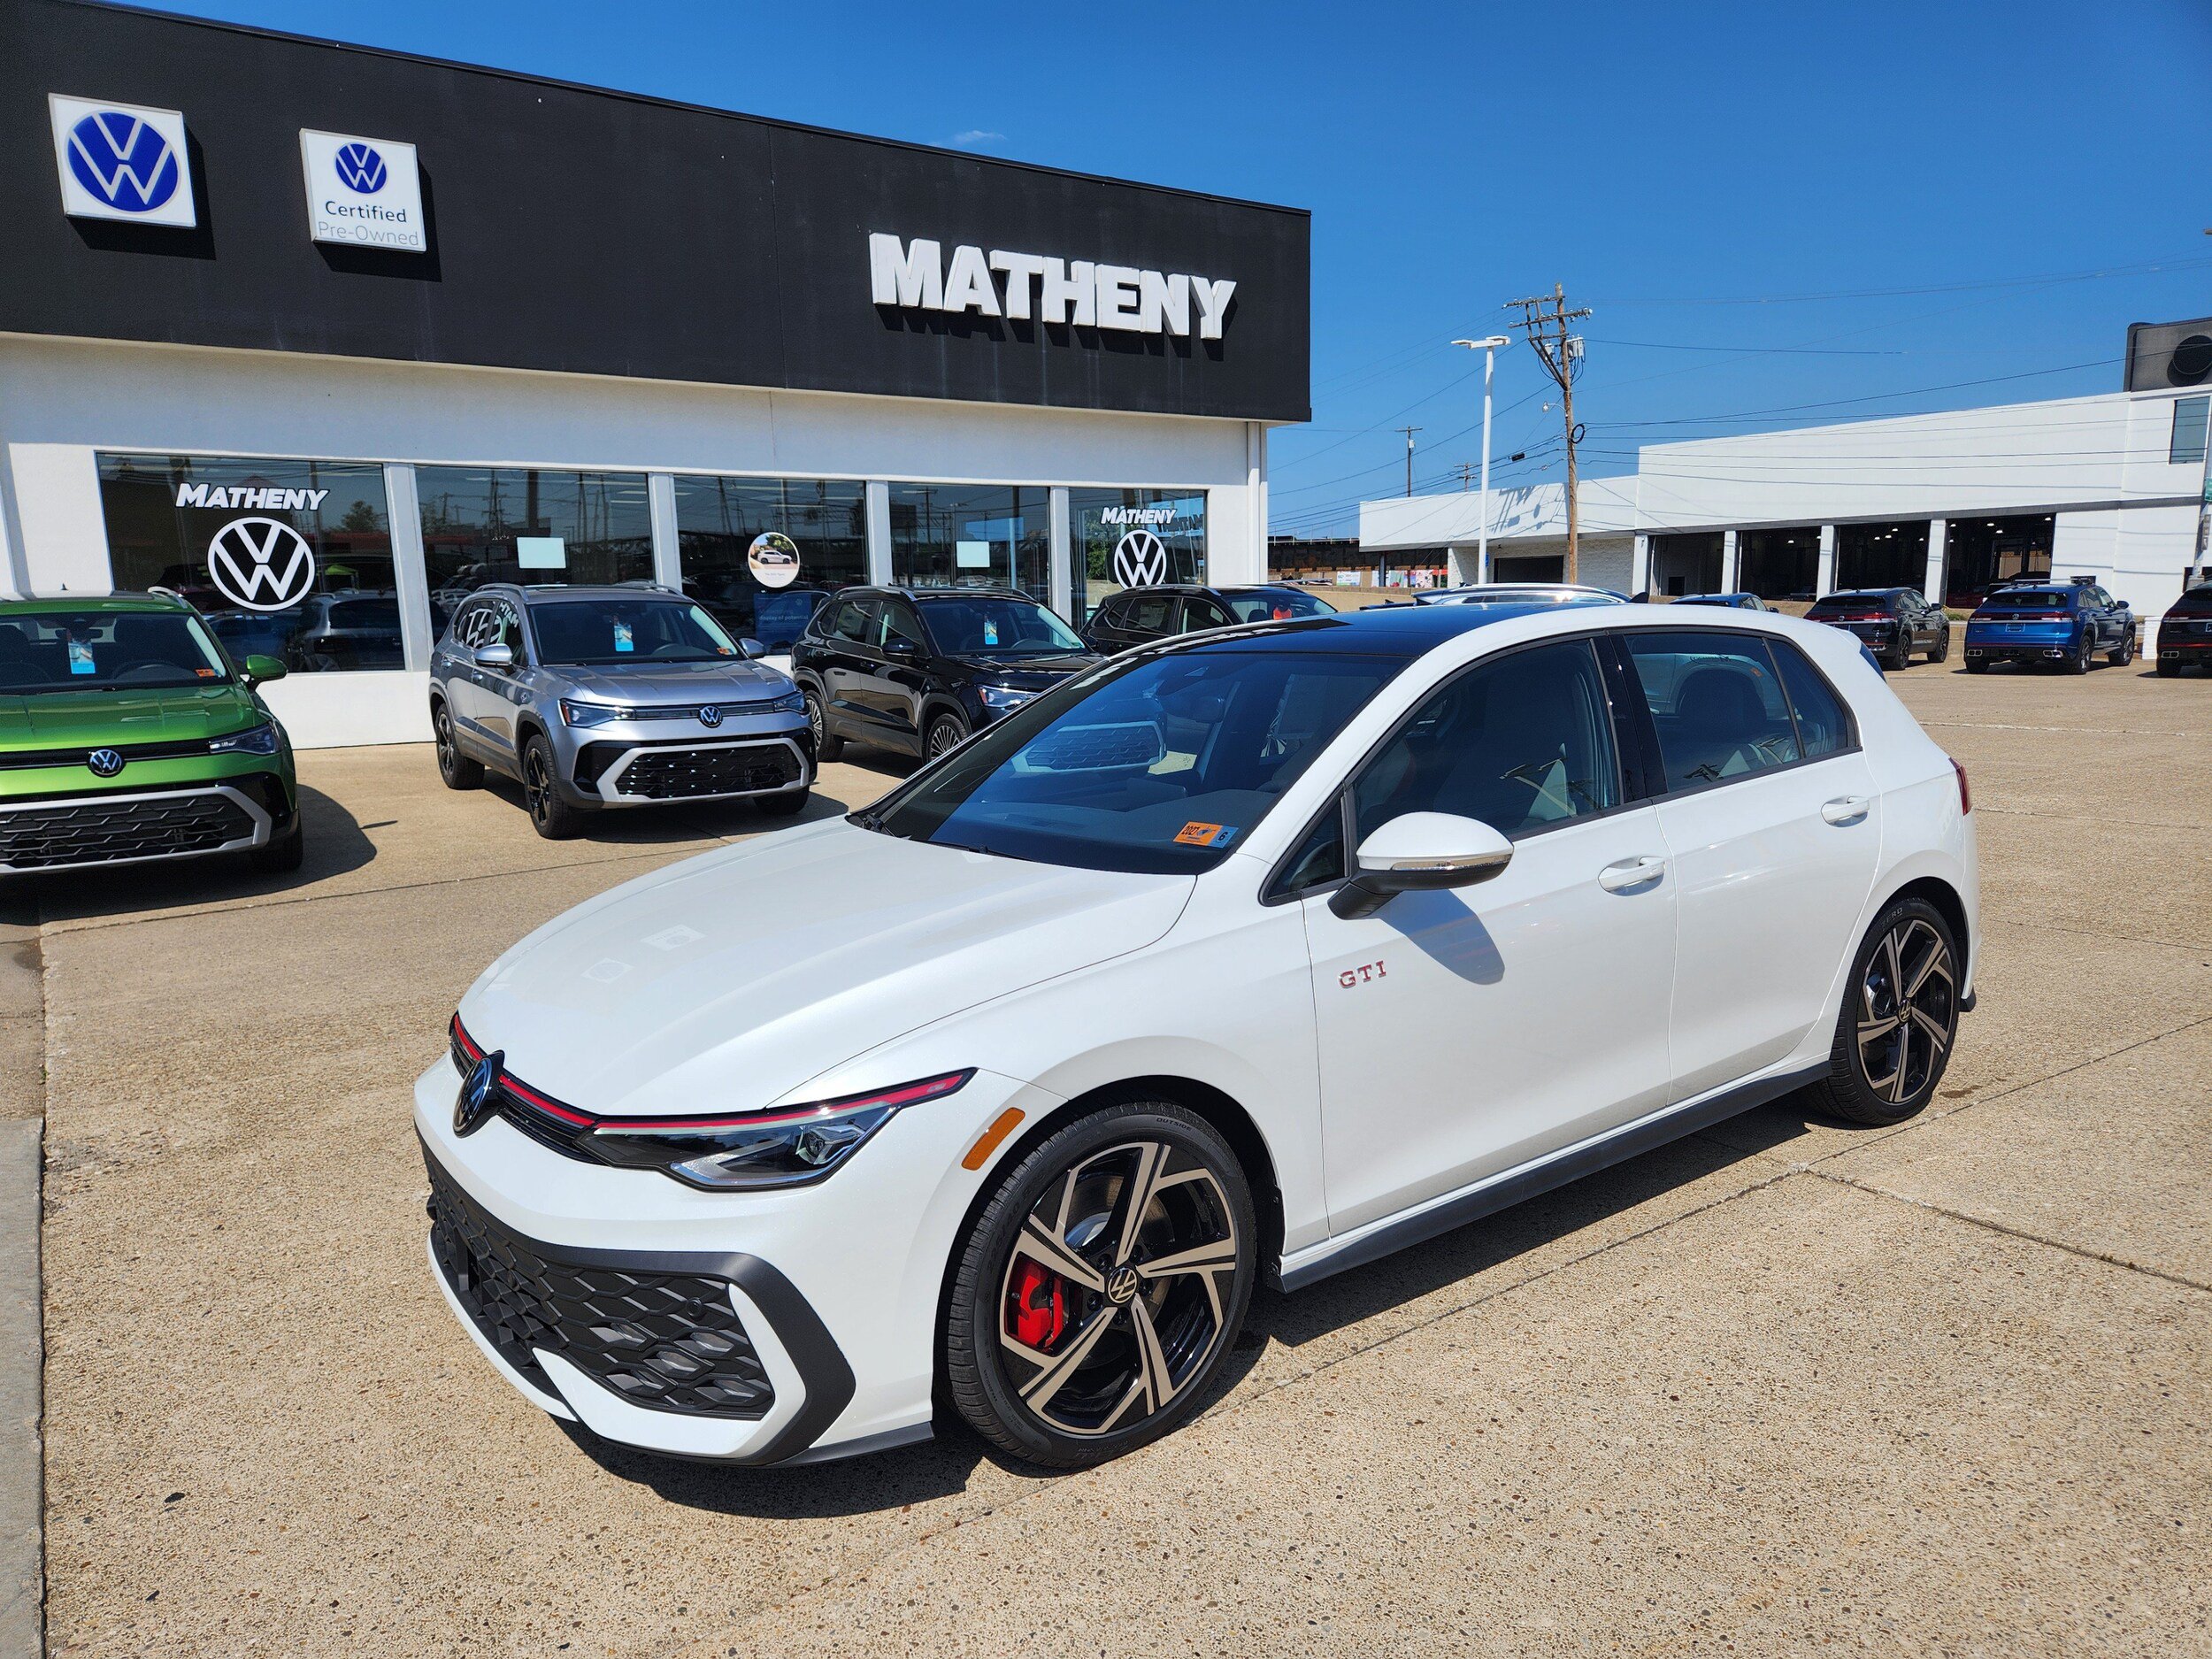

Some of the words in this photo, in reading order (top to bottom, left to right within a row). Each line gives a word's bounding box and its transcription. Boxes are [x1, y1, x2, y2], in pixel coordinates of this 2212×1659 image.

[65, 110, 180, 213] VW
[335, 142, 388, 194] VW
[325, 200, 407, 223] Certified
[318, 221, 419, 246] Pre-Owned
[869, 232, 1238, 340] MATHENY
[175, 482, 330, 511] MATHENY
[1101, 507, 1176, 524] MATHENY
[208, 517, 315, 611] VW
[1114, 529, 1167, 589] VW
[1339, 960, 1386, 989] GTI
[1156, 1118, 1193, 1132] OUTSIDE
